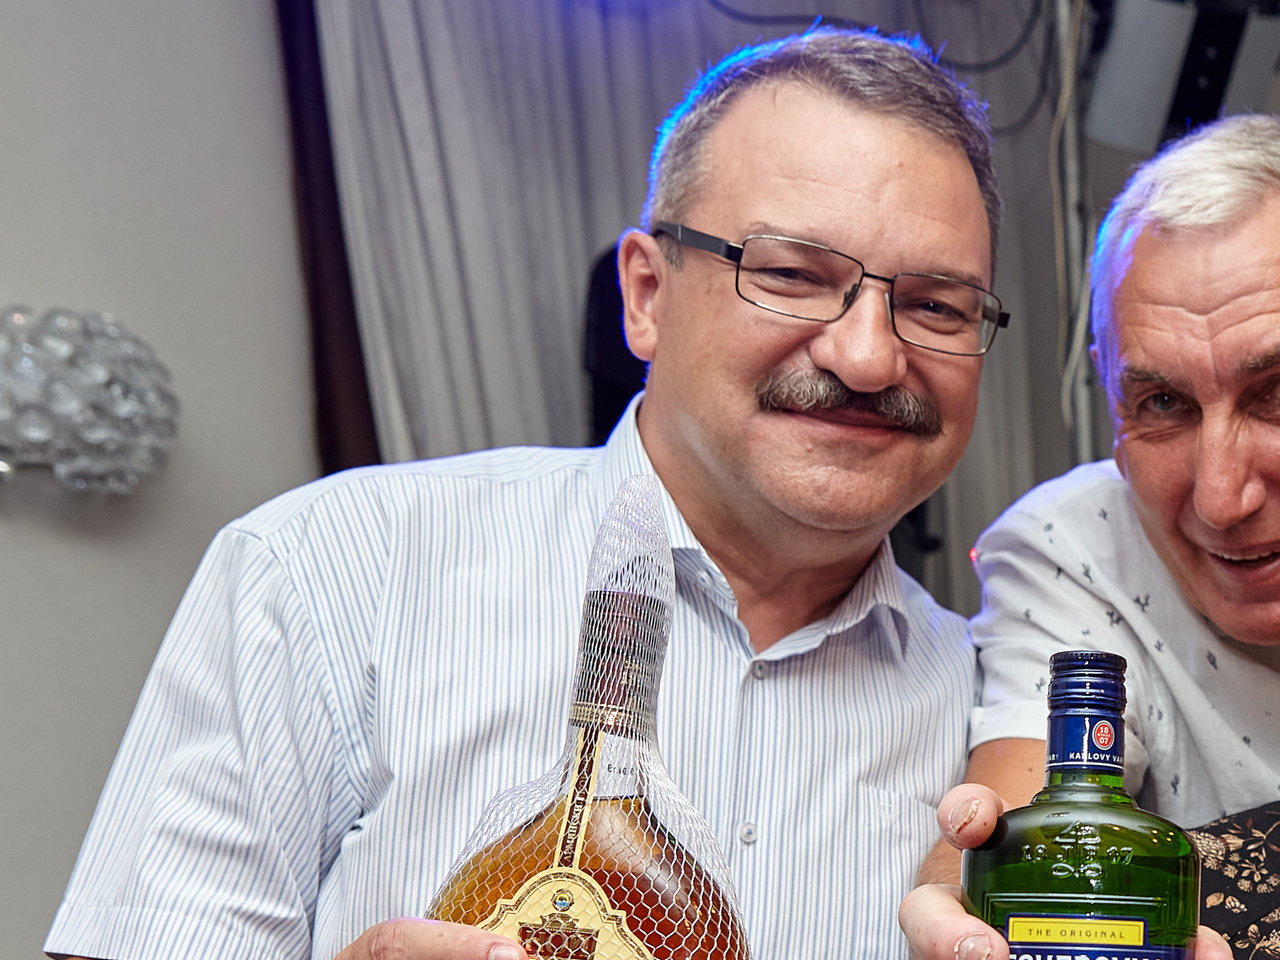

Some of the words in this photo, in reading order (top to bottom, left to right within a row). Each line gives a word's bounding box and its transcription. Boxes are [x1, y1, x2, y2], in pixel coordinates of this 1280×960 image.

[1100, 726, 1109, 734] 18
[1099, 737, 1109, 745] 07
[1112, 755, 1123, 763] VAR
[1028, 928, 1051, 937] THE
[1060, 929, 1125, 939] ORIGINAL
